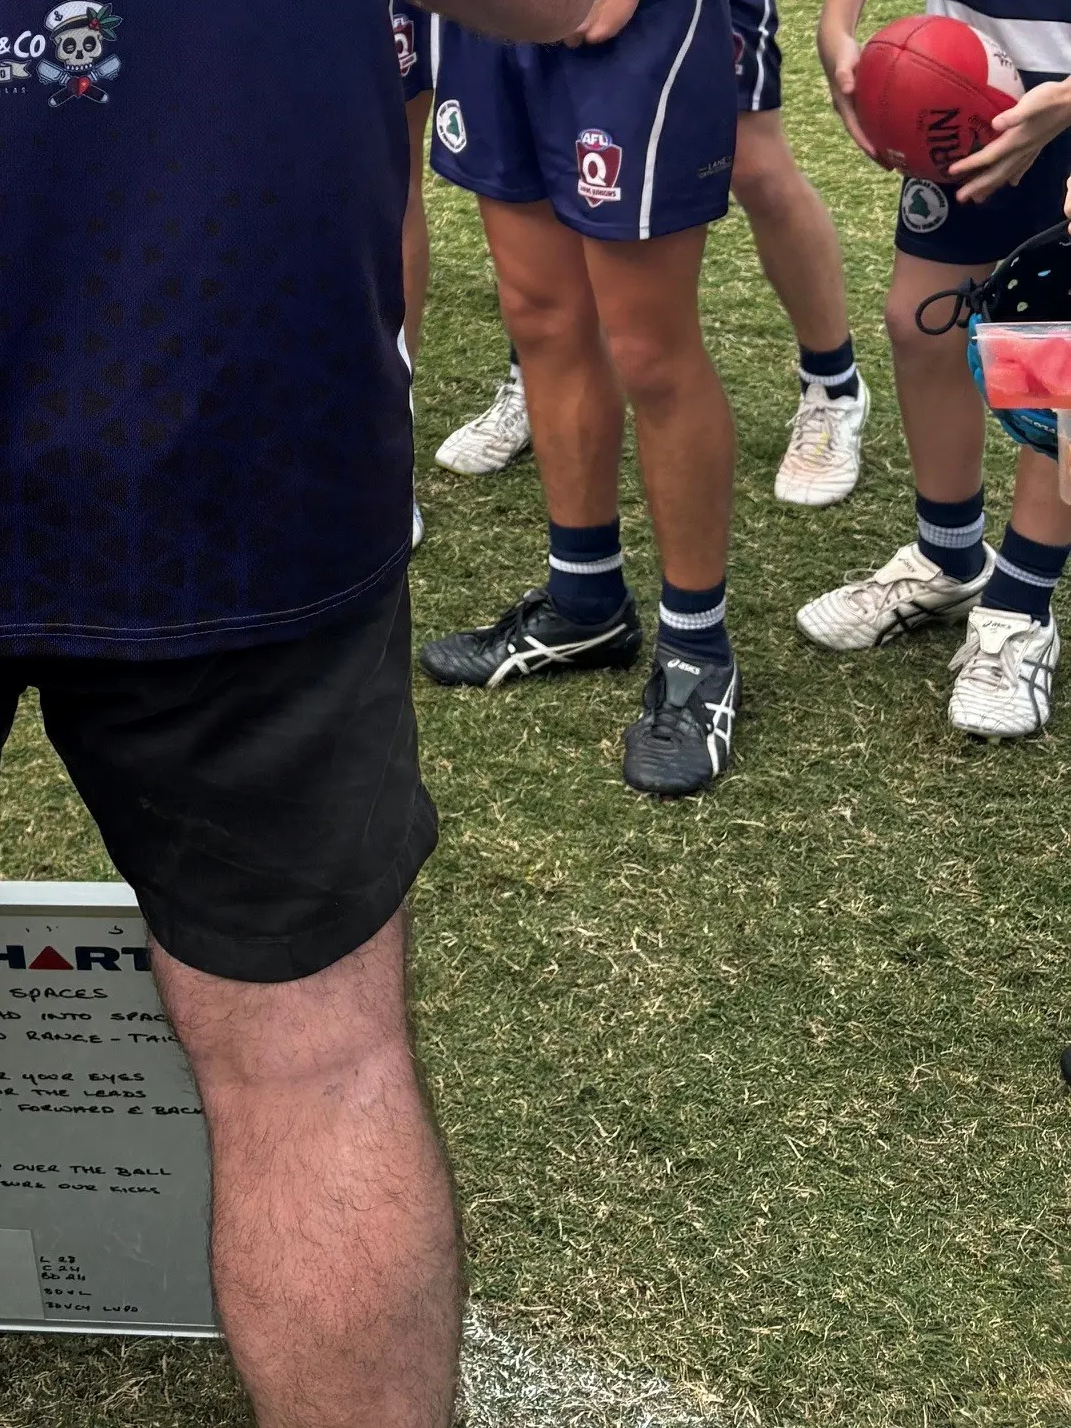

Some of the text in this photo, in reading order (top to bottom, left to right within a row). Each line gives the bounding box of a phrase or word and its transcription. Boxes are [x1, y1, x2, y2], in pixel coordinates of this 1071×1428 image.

[581, 132, 609, 146] AFL
[582, 152, 607, 186] Q
[10, 987, 108, 1003] SPACES
[41, 1012, 92, 1021] INTO
[110, 1011, 168, 1022] SPAC
[26, 1030, 102, 1043] RANGE
[89, 1073, 145, 1084] EYES
[32, 1088, 69, 1097] THE
[84, 1089, 146, 1098] LEADS
[18, 1103, 115, 1114] FORWARD
[13, 1164, 60, 1172] OVER
[70, 1165, 106, 1175] THE
[115, 1166, 172, 1177] BALL
[58, 1183, 98, 1191] OUR
[110, 1185, 160, 1194] KICKS
